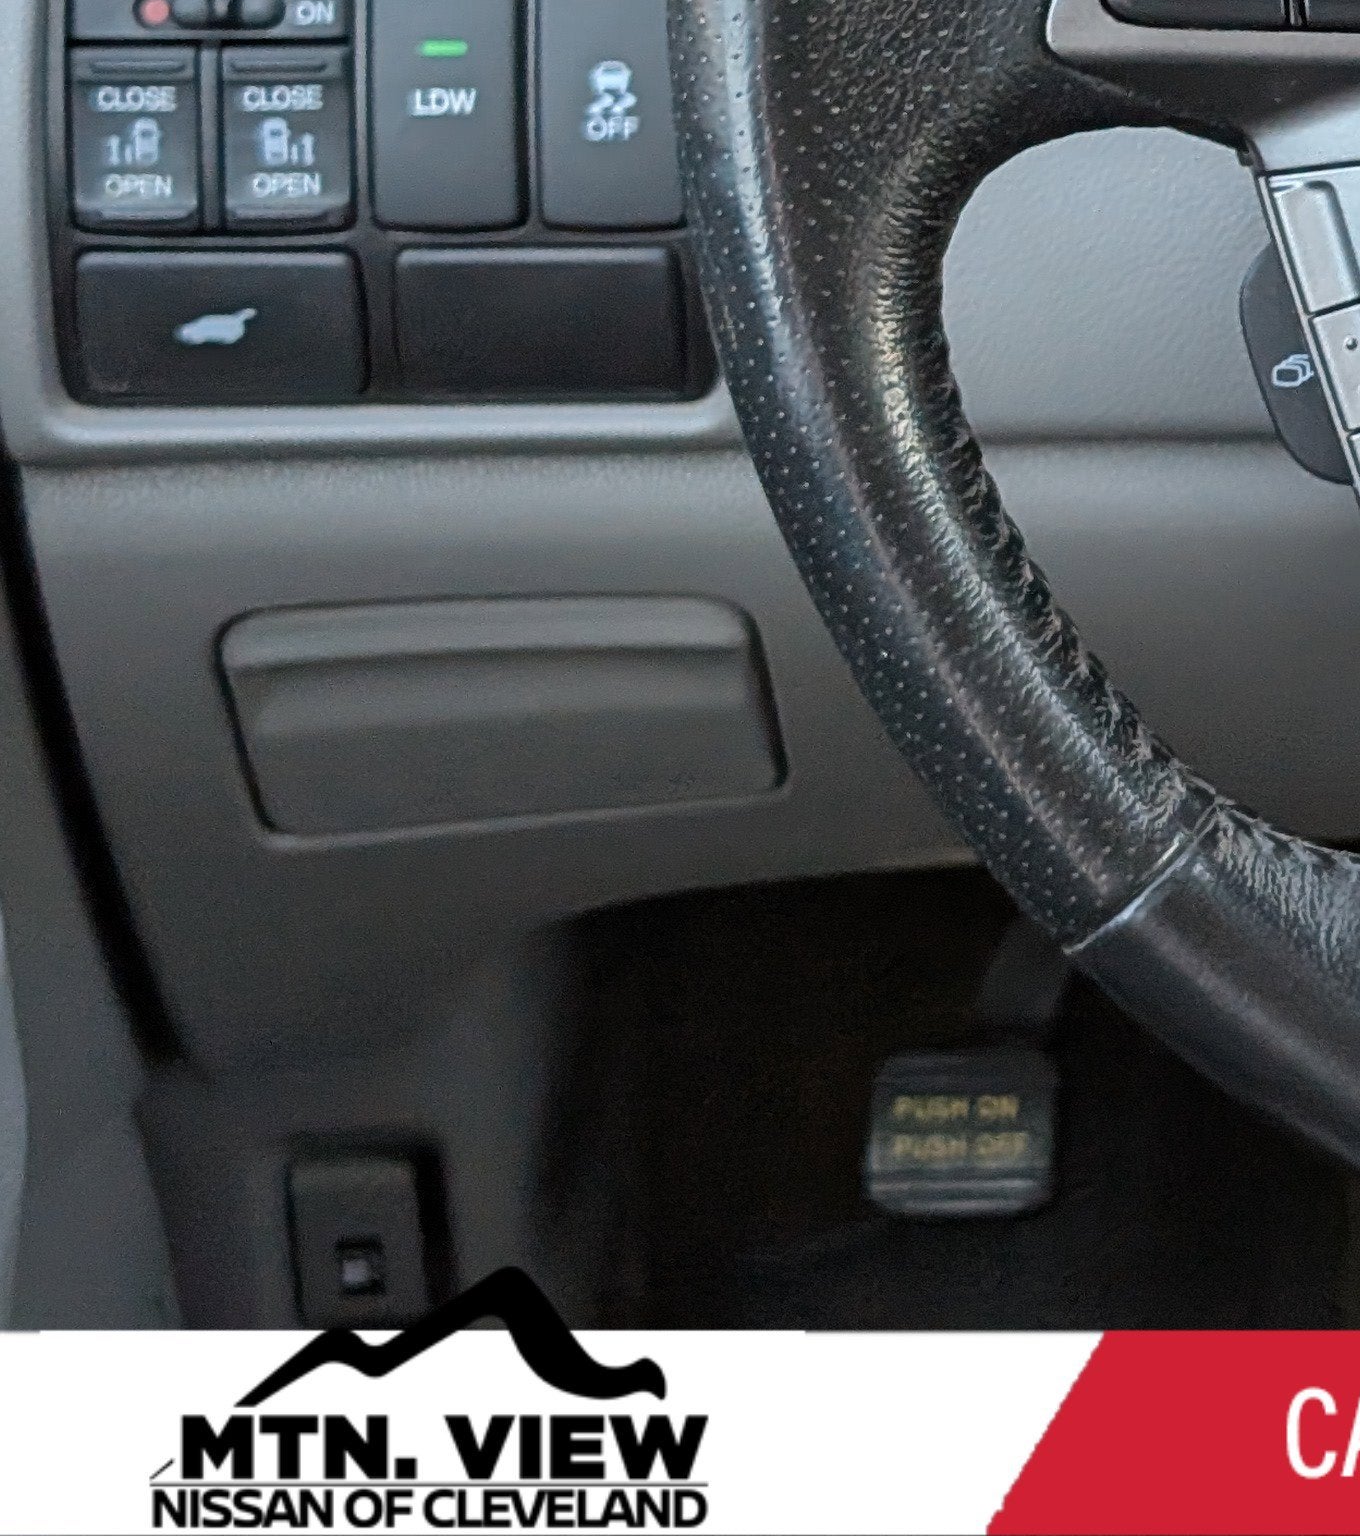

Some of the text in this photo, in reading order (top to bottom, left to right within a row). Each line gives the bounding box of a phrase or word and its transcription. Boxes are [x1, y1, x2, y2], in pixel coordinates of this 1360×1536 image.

[295, 0, 335, 25] ON
[96, 85, 178, 113] CLOSE
[241, 84, 325, 112] CLOSE
[411, 87, 478, 117] LDW
[583, 115, 643, 142] OFF
[103, 174, 174, 200] OPEN
[251, 172, 322, 199] OPEN
